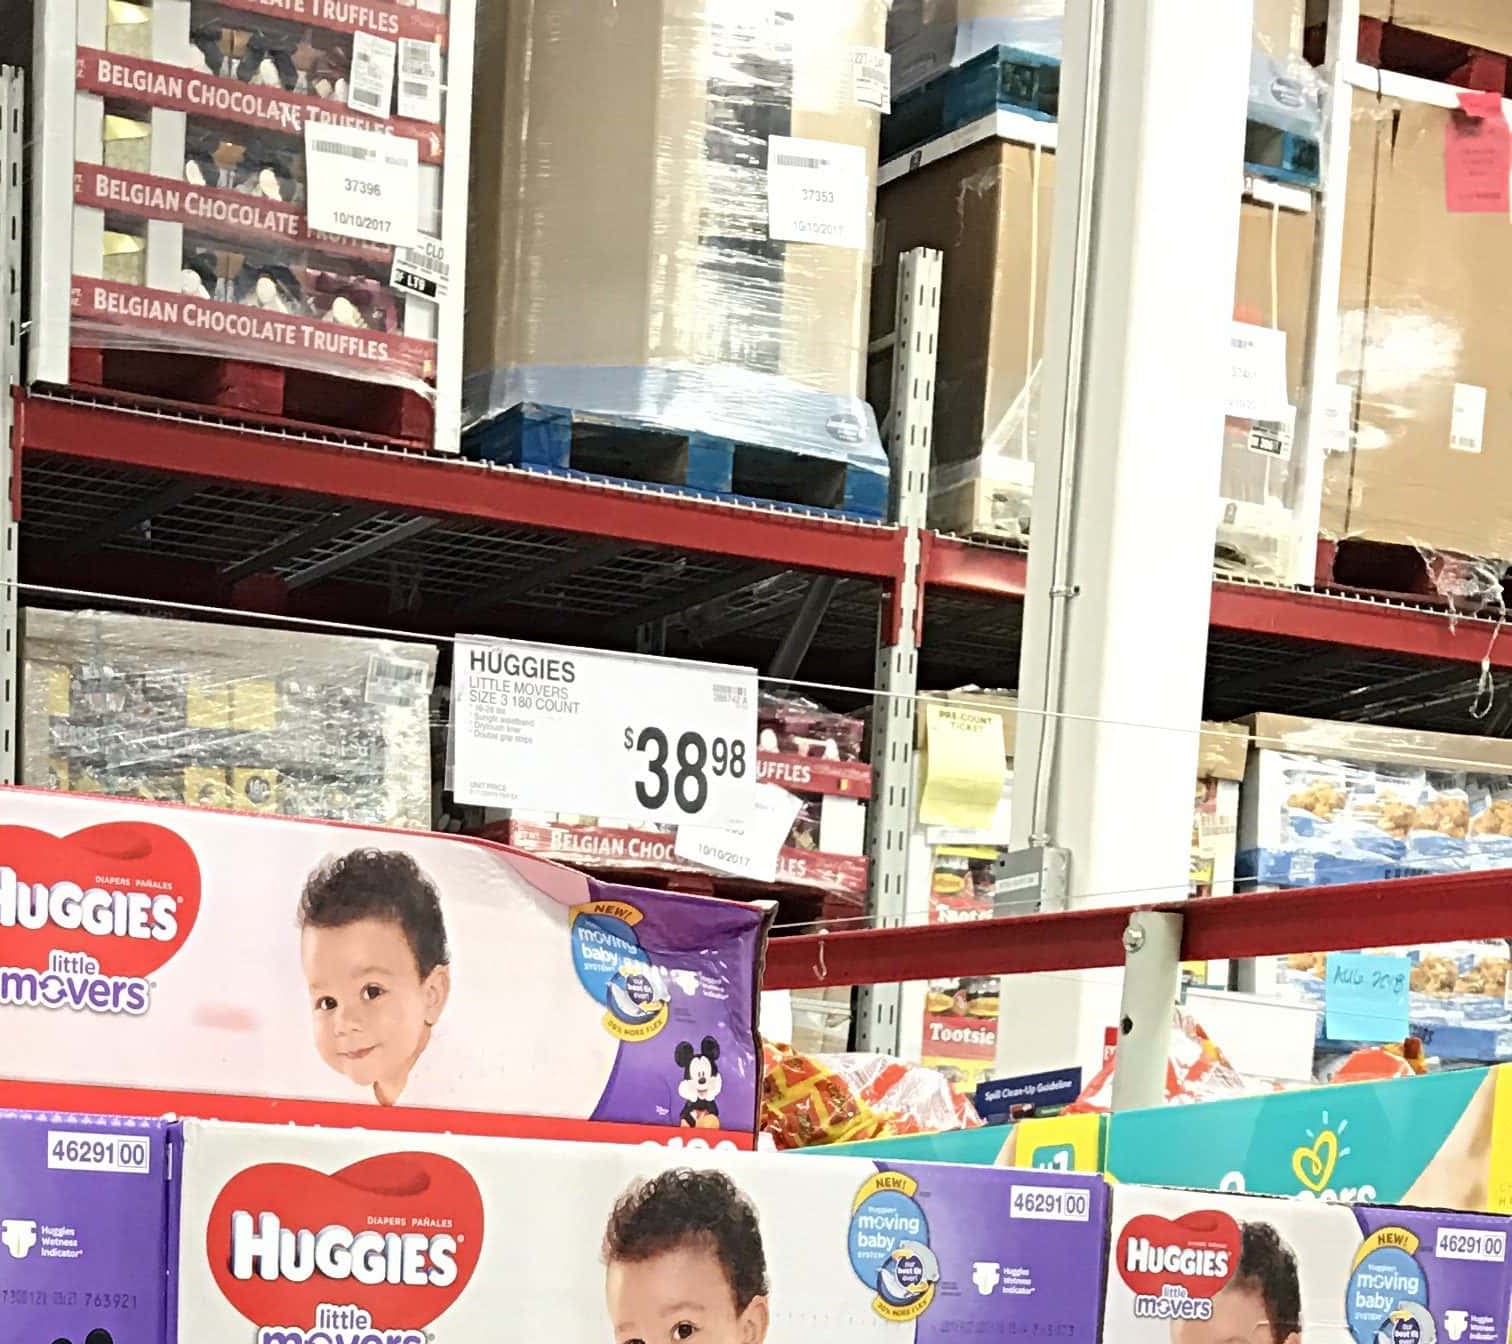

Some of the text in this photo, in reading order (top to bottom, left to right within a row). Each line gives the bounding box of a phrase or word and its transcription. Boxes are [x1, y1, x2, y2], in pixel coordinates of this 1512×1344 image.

[97, 59, 183, 99] BELGIAN
[187, 79, 301, 127] CHOCOLATE
[344, 178, 382, 197] 37396
[95, 174, 299, 237] BELGIAN CHOCOLATE
[333, 211, 392, 233] 10/10/2017
[93, 286, 389, 361] BELGIAN CHOCOLATE TRUFFLES
[470, 650, 576, 684] HUGGIES
[469, 677, 569, 699] LITTLE MOVERS
[469, 690, 581, 715] SIZE 3 180 COUNT
[550, 827, 625, 858] BELGIAN
[0, 967, 148, 1010] movers
[929, 1020, 997, 1047] Tootsie
[856, 1212, 920, 1235] moving
[229, 1209, 458, 1288] HUGGIES
[1125, 1237, 1231, 1281] HUGGIES
